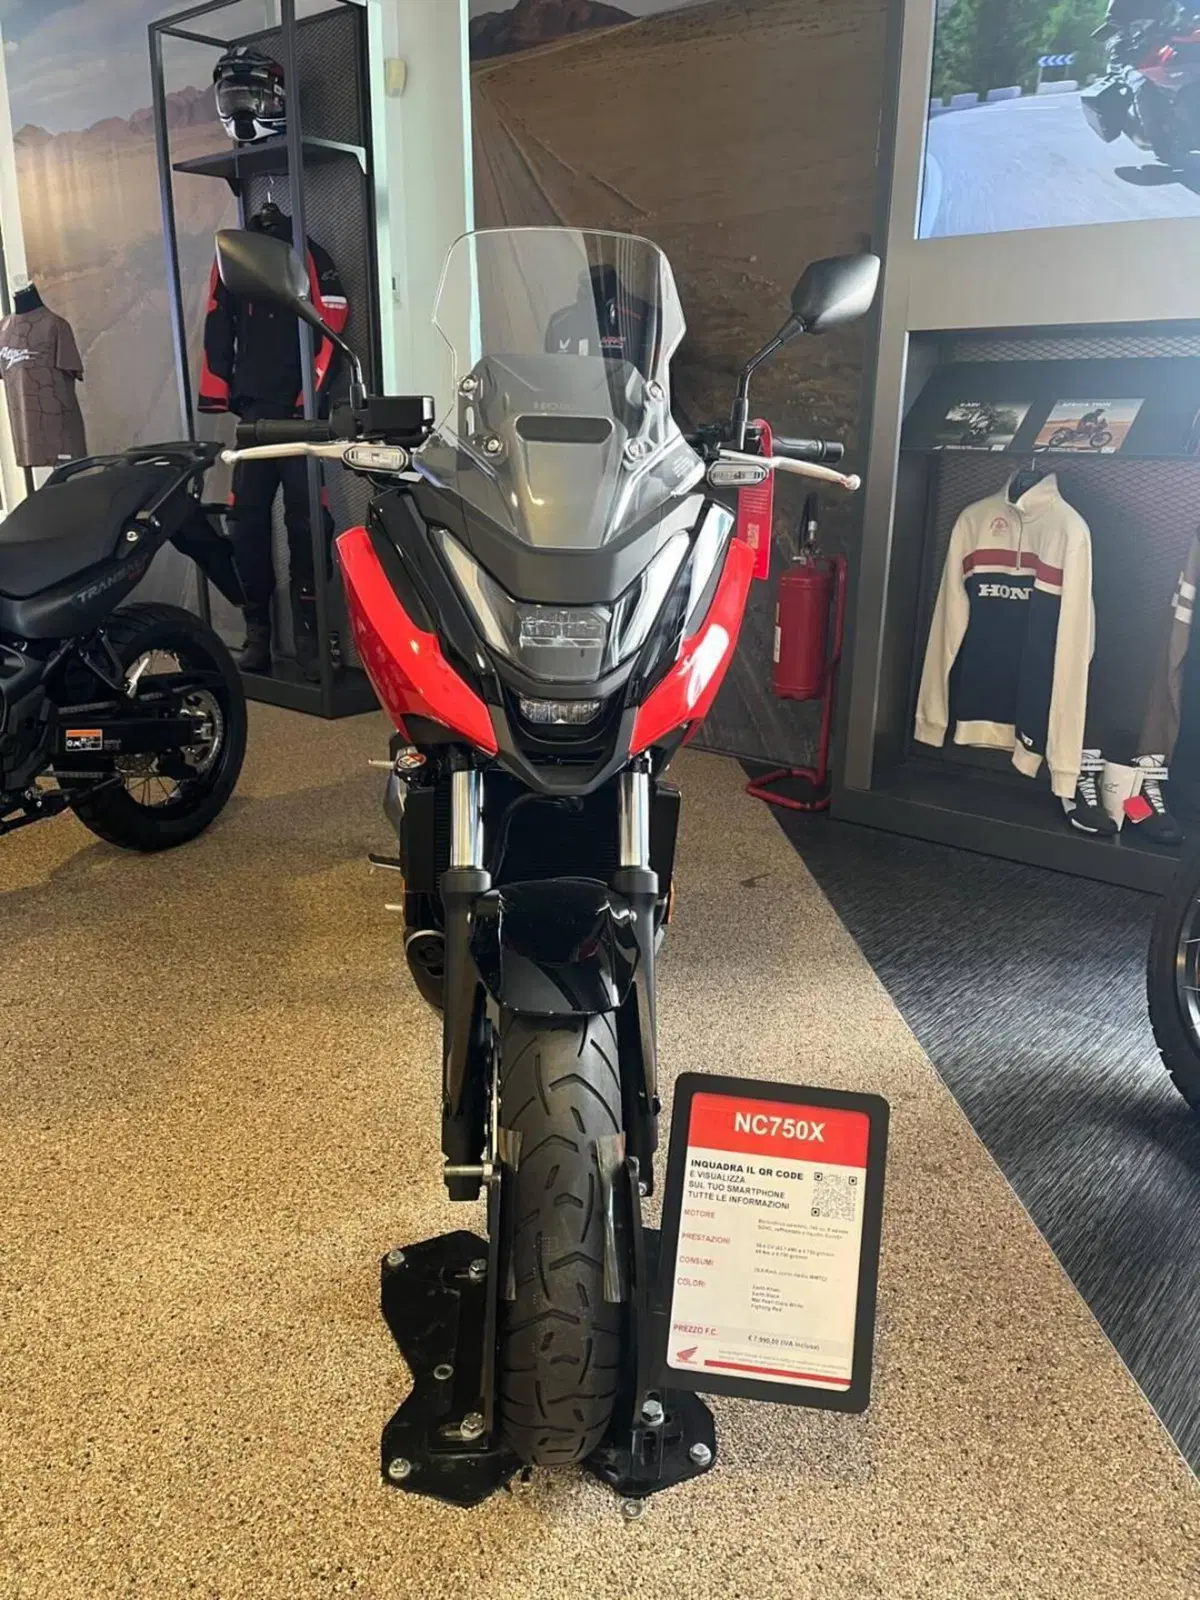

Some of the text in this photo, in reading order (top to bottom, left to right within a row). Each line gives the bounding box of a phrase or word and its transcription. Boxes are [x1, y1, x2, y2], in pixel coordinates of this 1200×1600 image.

[734, 1111, 827, 1143] NC750X
[691, 1159, 804, 1181] INQUADRA IL QR CODE
[697, 1171, 745, 1184] VISUALIZZA
[687, 1190, 790, 1210] TUTTE LE INFORMAZIONI
[688, 1180, 786, 1200] SUL TUO SMARTPHONE
[673, 1323, 703, 1334] PREZZO
